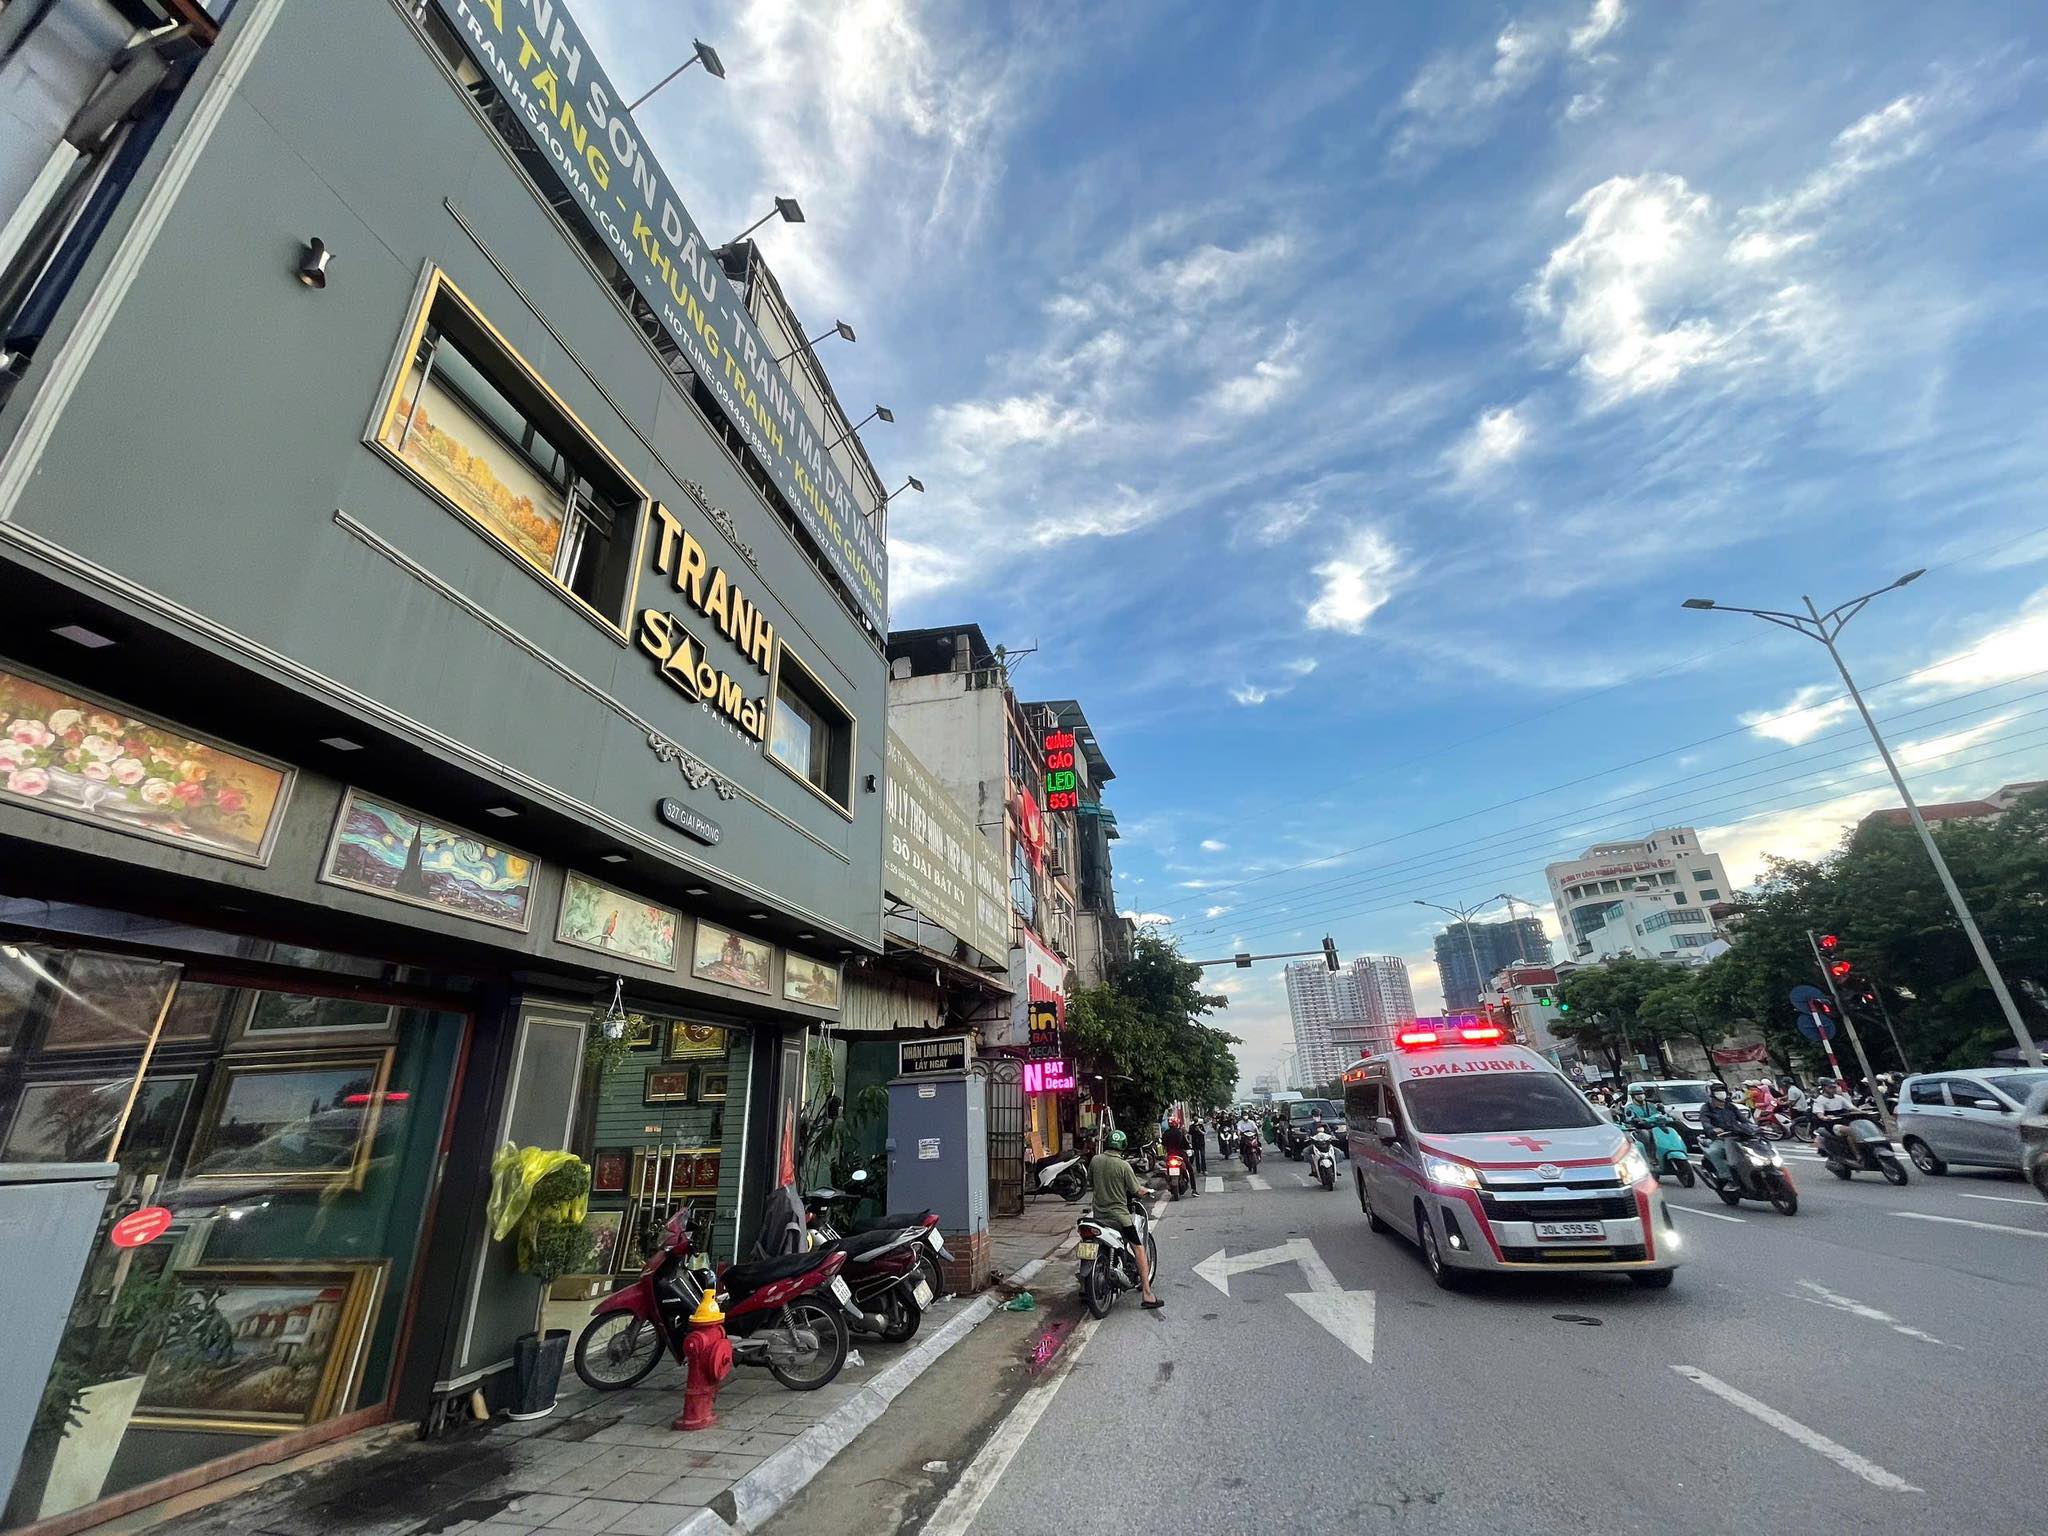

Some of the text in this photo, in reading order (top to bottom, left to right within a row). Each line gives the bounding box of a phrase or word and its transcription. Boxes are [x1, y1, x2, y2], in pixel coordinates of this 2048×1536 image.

[586, 81, 657, 210] SƠN
[661, 198, 717, 302] DẦU
[732, 308, 796, 437] TRANH
[798, 425, 822, 484] MẠ
[852, 510, 883, 580] VÀNG
[632, 211, 719, 360] KHUNG
[723, 347, 784, 457] TRANH
[794, 459, 842, 547] KHUNG
[663, 303, 715, 385] HOTLINE:
[751, 432, 773, 467] 8855
[656, 502, 774, 674] TRANH
[702, 703, 758, 751] GALLERY
[1048, 751, 1073, 769] CÁO
[1047, 771, 1075, 792] LED
[1050, 792, 1076, 809] 531
[666, 803, 680, 820] 527
[892, 834, 909, 867] ĐỘ
[939, 1041, 963, 1056] KHUNG
[1031, 1045, 1057, 1057] DECAL
[929, 1059, 948, 1069] NGAY
[1045, 1076, 1074, 1089] Decal
